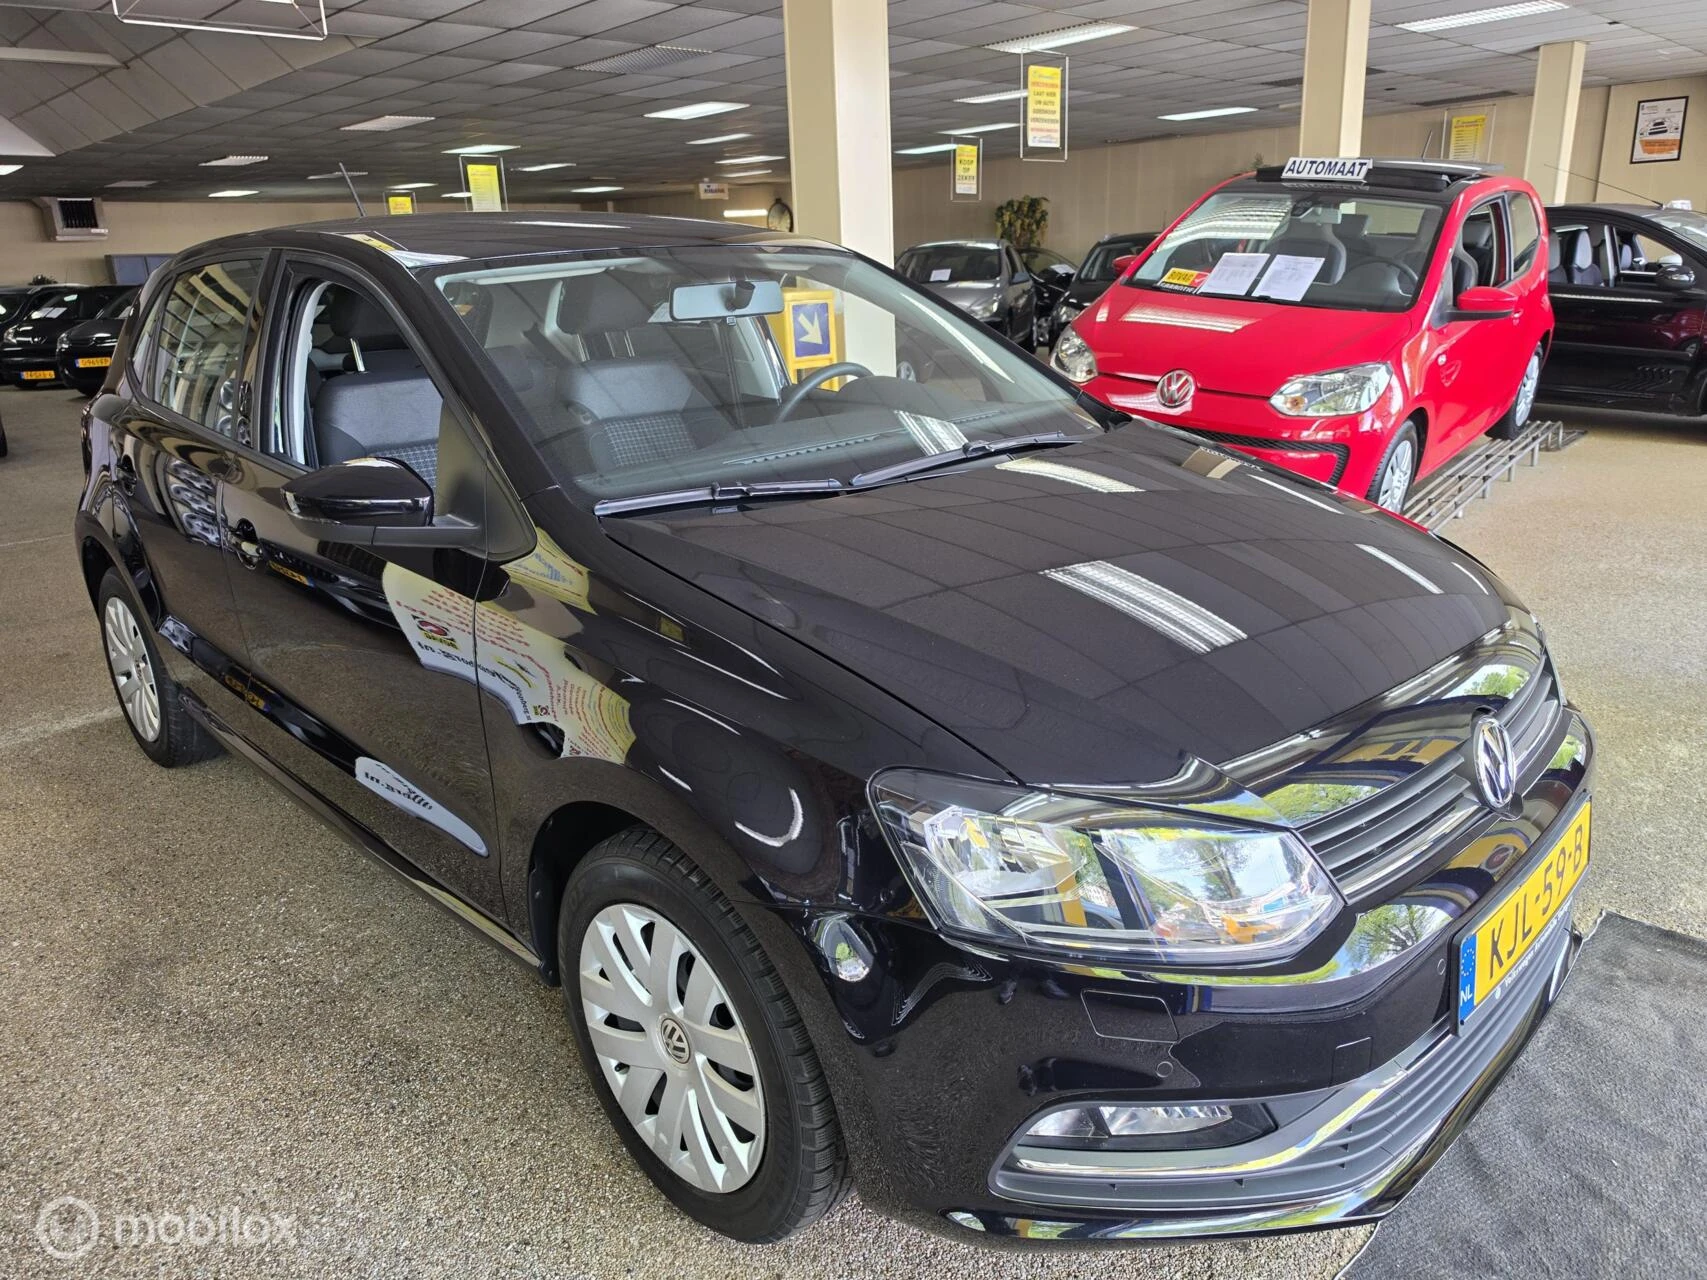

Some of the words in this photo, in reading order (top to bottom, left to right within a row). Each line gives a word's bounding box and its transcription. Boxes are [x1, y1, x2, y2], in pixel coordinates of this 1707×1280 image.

[1285, 159, 1368, 177] AUTOMAAT
[1489, 823, 1584, 981] KJL-59-B
[1460, 985, 1474, 1007] NL
